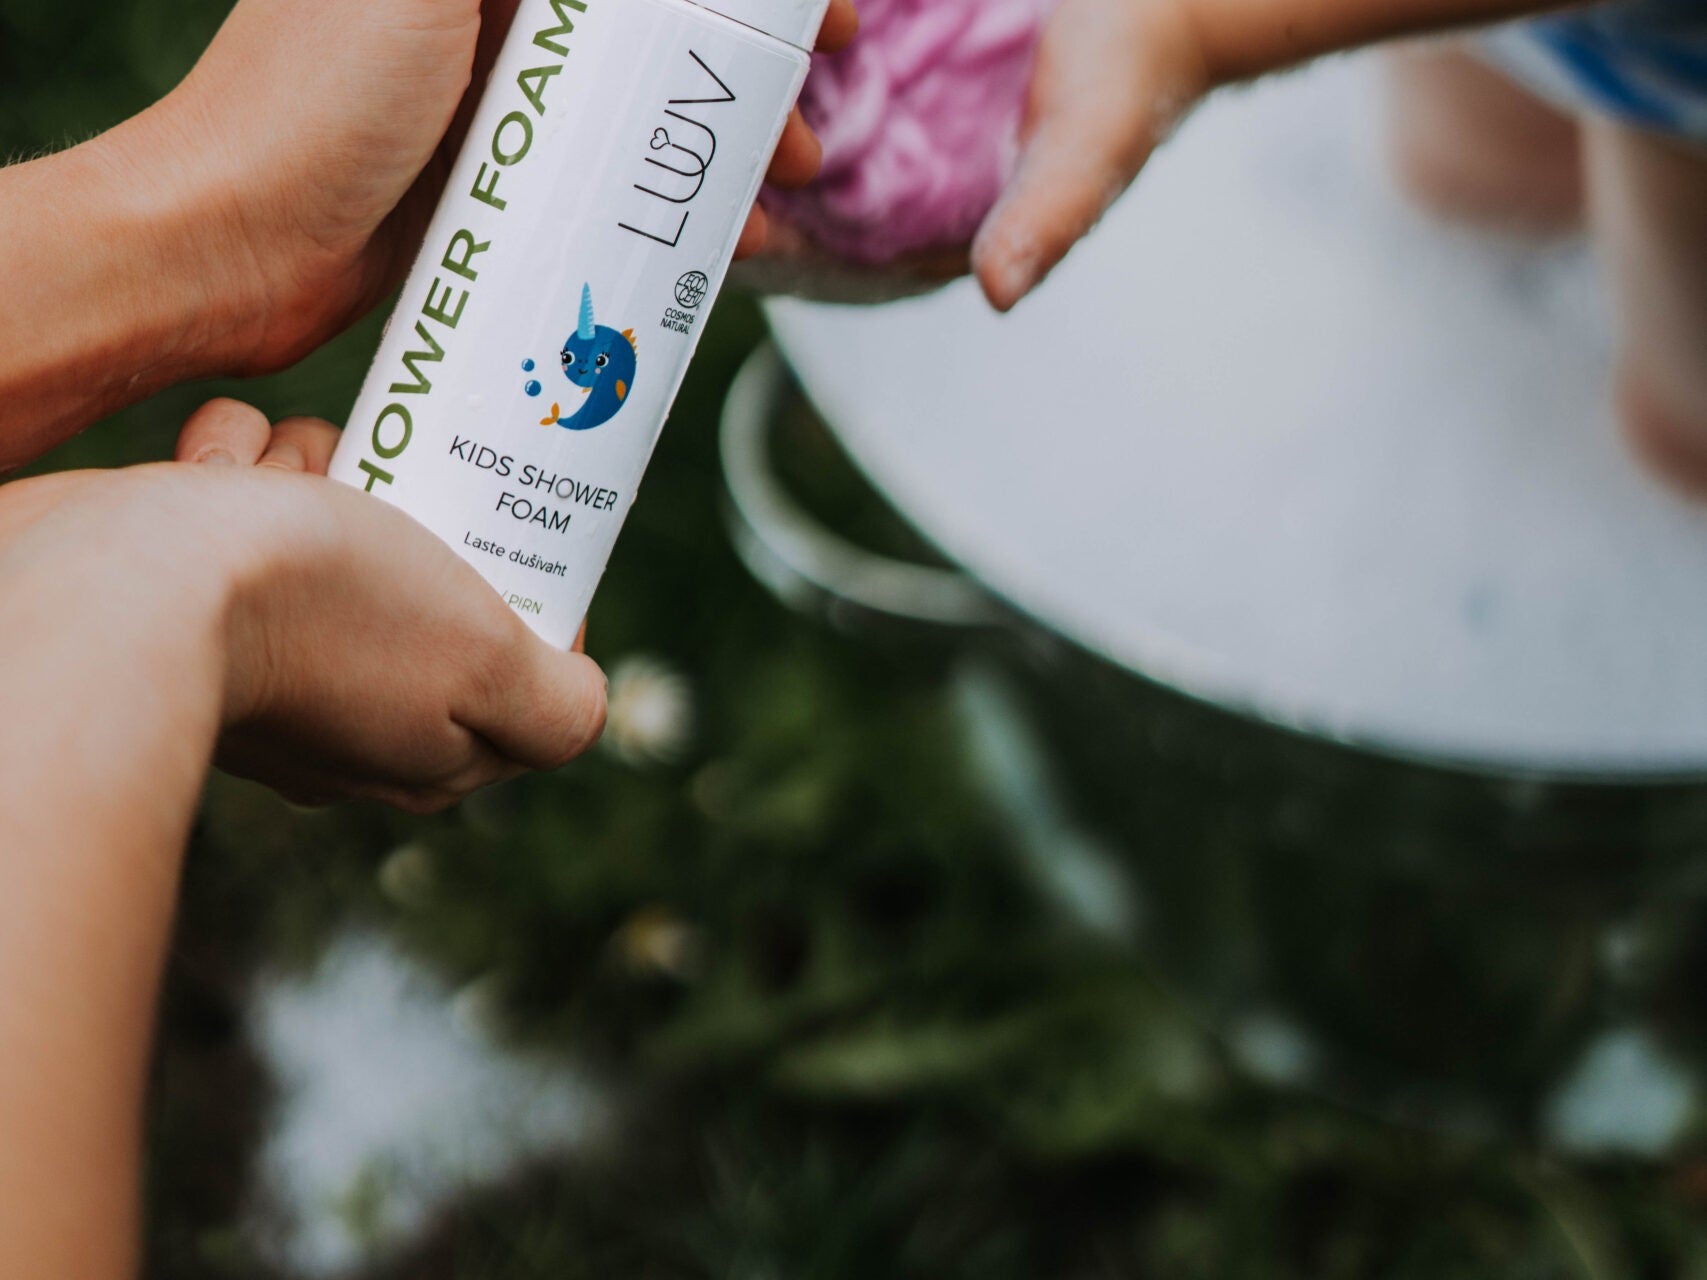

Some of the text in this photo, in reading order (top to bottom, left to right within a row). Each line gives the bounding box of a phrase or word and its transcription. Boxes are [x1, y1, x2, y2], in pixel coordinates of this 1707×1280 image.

[660, 318, 690, 335] NATURAL
[664, 307, 696, 324] COSMOS
[357, 227, 492, 493] HOWER
[449, 435, 618, 511] KIDS SHOWER
[495, 491, 571, 534] FOAM
[463, 531, 568, 577] Laste dušivaht
[507, 593, 543, 615] PIRN
